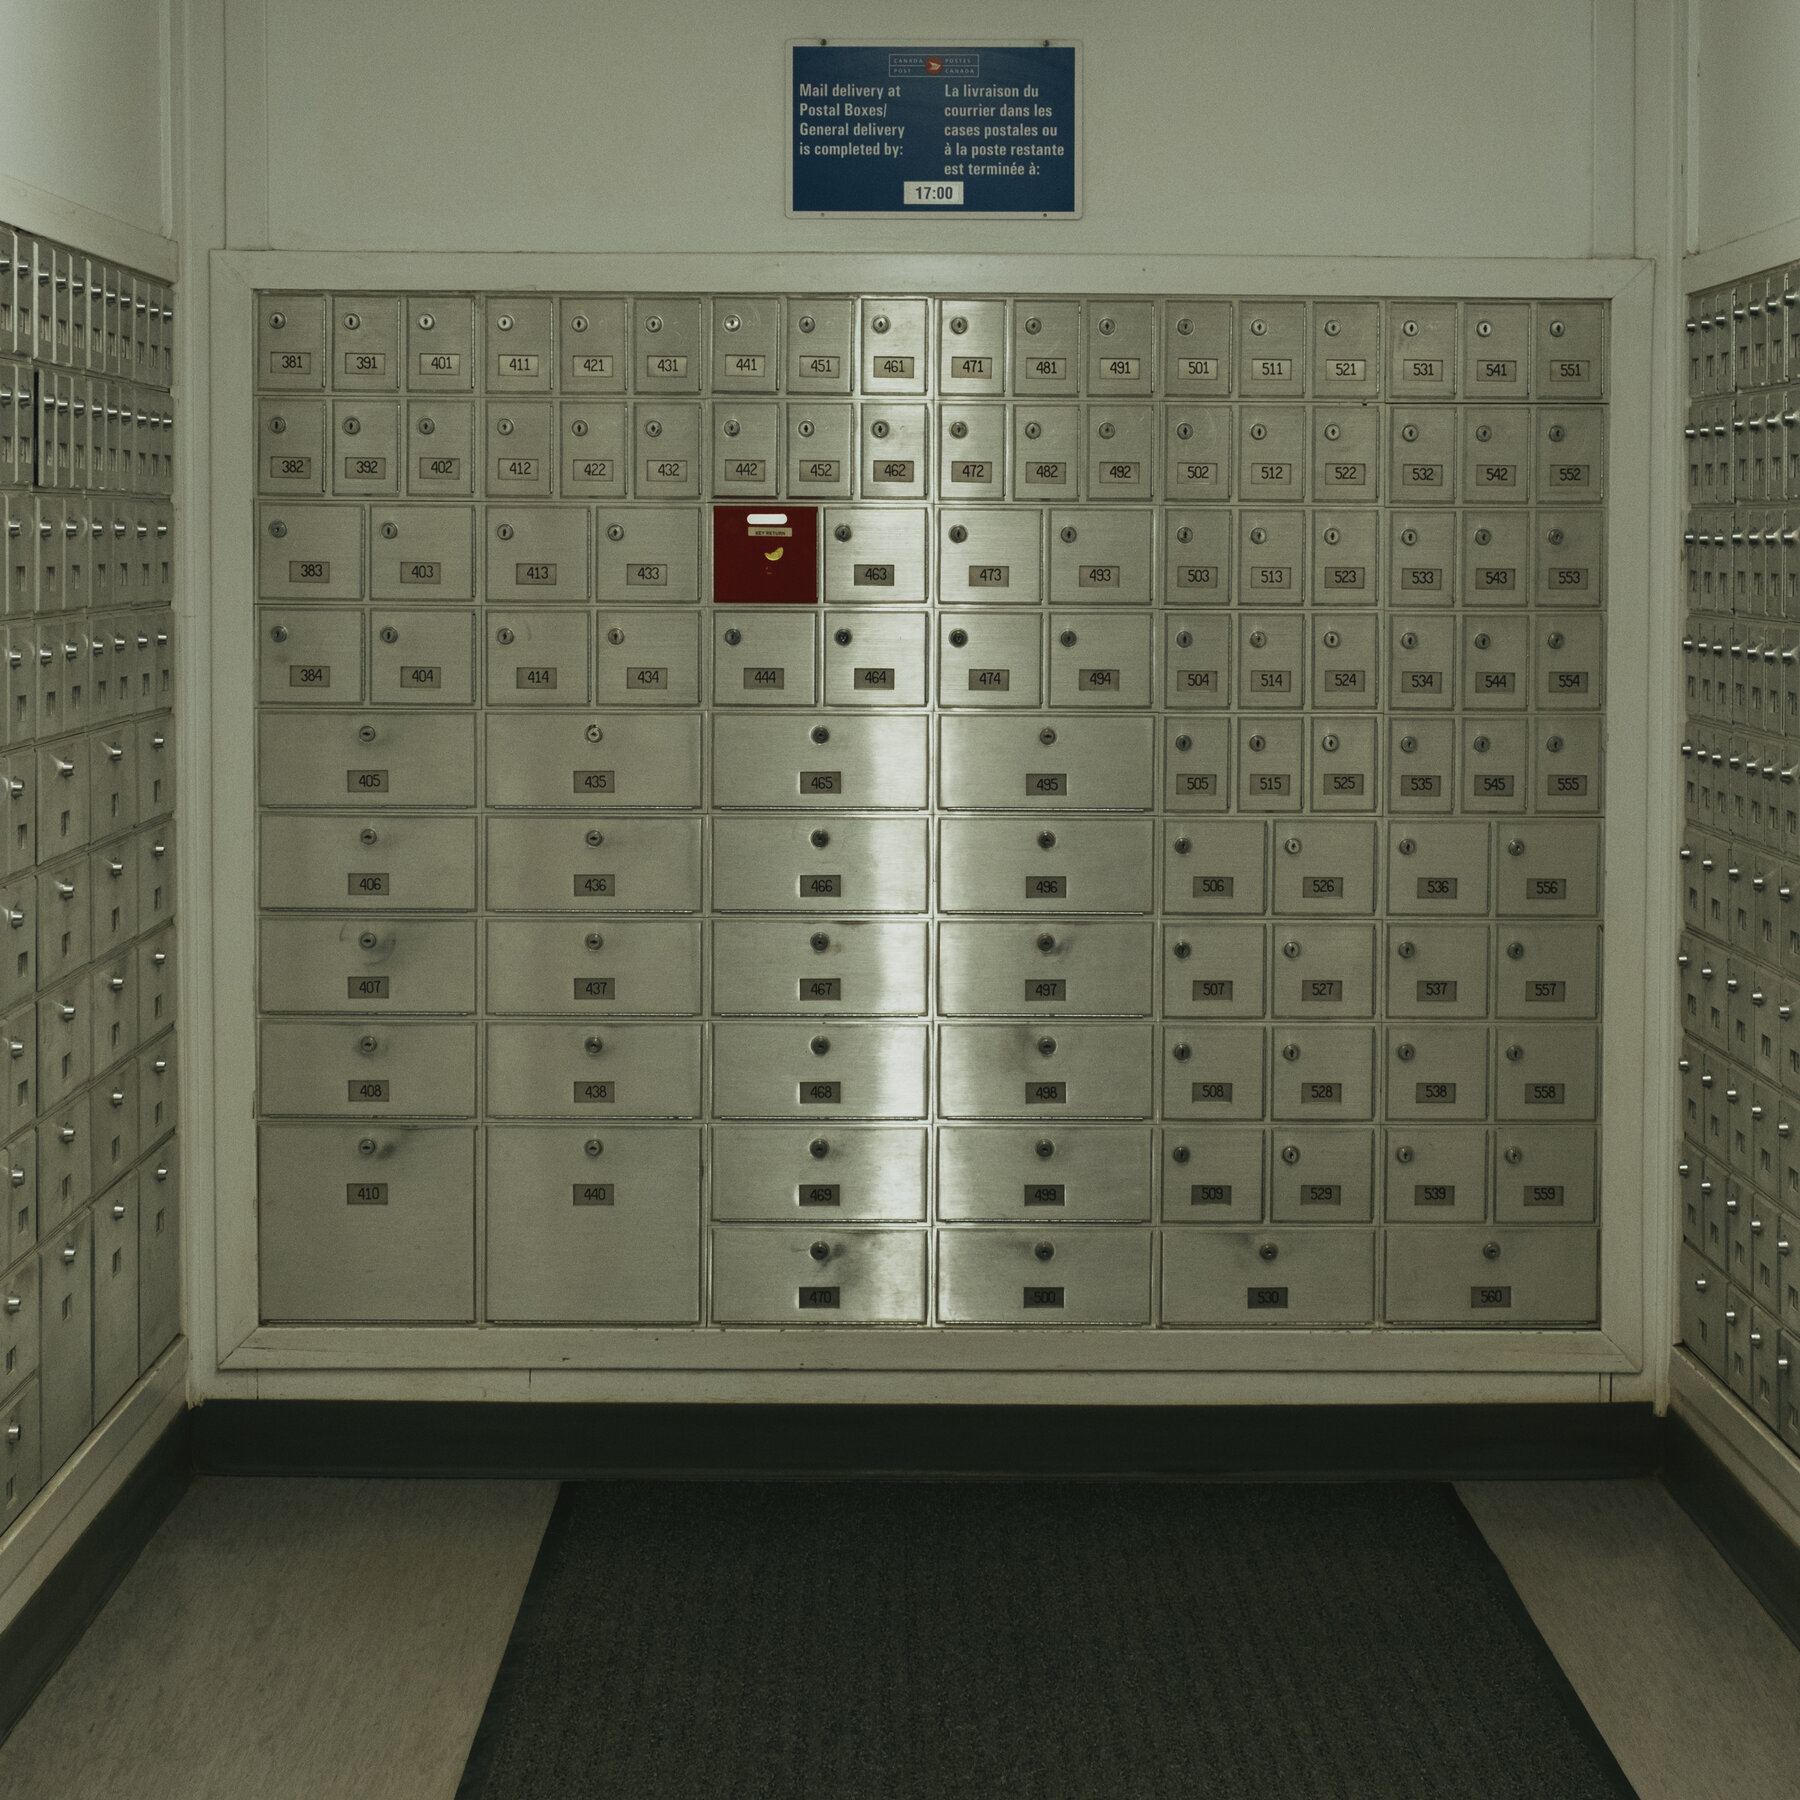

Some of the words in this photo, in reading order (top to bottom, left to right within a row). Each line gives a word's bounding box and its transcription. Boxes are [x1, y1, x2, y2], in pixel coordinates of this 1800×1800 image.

[800, 84, 827, 96] Mail
[833, 84, 883, 99] delivery
[888, 86, 900, 96] at
[945, 84, 959, 96] La
[964, 84, 1018, 97] livraison
[1024, 84, 1038, 97] du
[800, 103, 839, 116] Postal
[845, 103, 887, 117] Boxes/
[945, 104, 995, 116] courrier
[1000, 104, 1029, 116] dans
[1035, 104, 1052, 116] les
[800, 123, 848, 135] General
[854, 123, 904, 138] delivery
[945, 127, 980, 136] cases
[985, 124, 1038, 139] postales
[1043, 127, 1057, 136] ou
[800, 142, 810, 155] is
[815, 142, 880, 158] completed
[885, 143, 903, 158] by:
[945, 143, 951, 155] à
[957, 143, 967, 155] la
[972, 144, 1006, 158] poste
[1011, 145, 1064, 155] restante
[945, 164, 963, 175] est
[968, 162, 1024, 175] terminée
[1029, 162, 1039, 175] à:
[916, 187, 952, 199] 17:00
[281, 355, 303, 369] 381
[356, 355, 378, 370] 391
[430, 356, 453, 370] 401
[509, 358, 531, 371] 411
[583, 358, 605, 372] 421
[657, 358, 679, 372] 431
[735, 358, 758, 371] 441
[810, 359, 832, 373] 451
[883, 359, 905, 373] 461
[962, 359, 984, 373] 471
[1036, 361, 1057, 375] 481
[1109, 361, 1131, 375] 491
[1188, 361, 1210, 375] 501
[1262, 362, 1283, 376] 511
[1335, 362, 1357, 377] 521
[1413, 362, 1435, 377] 531
[1486, 363, 1508, 377] 541
[1560, 363, 1582, 377] 551
[282, 459, 304, 474] 382
[356, 460, 378, 474] 392
[430, 460, 453, 474] 402
[509, 461, 532, 475] 412
[583, 462, 606, 477] 422
[657, 463, 680, 477] 432
[735, 462, 758, 477] 442
[810, 463, 833, 477] 452
[884, 463, 906, 477] 462
[962, 464, 984, 478] 472
[1036, 464, 1059, 478] 482
[1109, 465, 1132, 479] 492
[1187, 465, 1209, 479] 502
[1261, 465, 1283, 480] 512
[1335, 466, 1357, 480] 522
[1412, 467, 1434, 481] 532
[1486, 467, 1508, 481] 542
[1559, 467, 1581, 482] 552
[300, 563, 323, 578] 383
[411, 564, 434, 579] 403
[526, 565, 549, 580] 413
[637, 566, 660, 580] 433
[864, 567, 887, 581] 463
[979, 567, 1002, 582] 473
[1089, 568, 1112, 582] 493
[1187, 569, 1210, 583] 503
[1260, 569, 1283, 584] 513
[1334, 569, 1357, 584] 523
[1412, 570, 1434, 585] 533
[1485, 570, 1508, 585] 543
[1558, 570, 1581, 585] 553
[300, 668, 323, 682] 384
[411, 669, 434, 683] 404
[527, 670, 550, 684] 414
[637, 670, 659, 684] 434
[754, 670, 777, 684] 444
[864, 670, 887, 684] 464
[978, 671, 1001, 685] 474
[1089, 671, 1112, 686] 494
[1187, 672, 1210, 687] 504
[1260, 673, 1283, 687] 514
[1335, 673, 1357, 687] 524
[1411, 674, 1434, 688] 534
[1485, 674, 1507, 689] 544
[1558, 674, 1580, 688] 554
[358, 773, 381, 788] 405
[584, 774, 607, 789] 435
[811, 775, 833, 790] 465
[1036, 777, 1059, 792] 495
[1186, 776, 1209, 791] 505
[1259, 776, 1282, 791] 515
[1333, 776, 1356, 790] 525
[1410, 777, 1433, 791] 535
[1483, 777, 1506, 792] 545
[1557, 777, 1580, 792] 555
[359, 877, 382, 891] 406
[584, 878, 607, 892] 436
[810, 879, 833, 893] 466
[1036, 880, 1058, 894] 496
[1202, 878, 1225, 893] 506
[1312, 879, 1335, 893] 526
[1427, 880, 1450, 894] 536
[1536, 880, 1558, 895] 556
[359, 980, 381, 994] 407
[585, 981, 608, 996] 437
[810, 982, 833, 996] 467
[1035, 983, 1057, 997] 497
[1203, 982, 1225, 997] 507
[1312, 982, 1334, 996] 527
[1426, 982, 1448, 996] 537
[1535, 982, 1557, 997] 557
[359, 1083, 382, 1098] 408
[584, 1084, 607, 1099] 438
[810, 1085, 833, 1099] 468
[1035, 1086, 1058, 1100] 498
[1202, 1084, 1225, 1098] 508
[1311, 1084, 1334, 1099] 528
[1425, 1084, 1448, 1098] 538
[1534, 1085, 1556, 1099] 558
[357, 1186, 380, 1201] 410
[583, 1187, 606, 1201] 440
[809, 1188, 833, 1202] 469
[1034, 1188, 1057, 1202] 499
[1201, 1186, 1224, 1201] 509
[1310, 1186, 1333, 1201] 529
[1424, 1186, 1447, 1201] 539
[1533, 1186, 1556, 1201] 559
[809, 1290, 832, 1304] 470
[1034, 1290, 1056, 1304] 500
[1257, 1290, 1280, 1305] 530
[1480, 1289, 1503, 1304] 560
